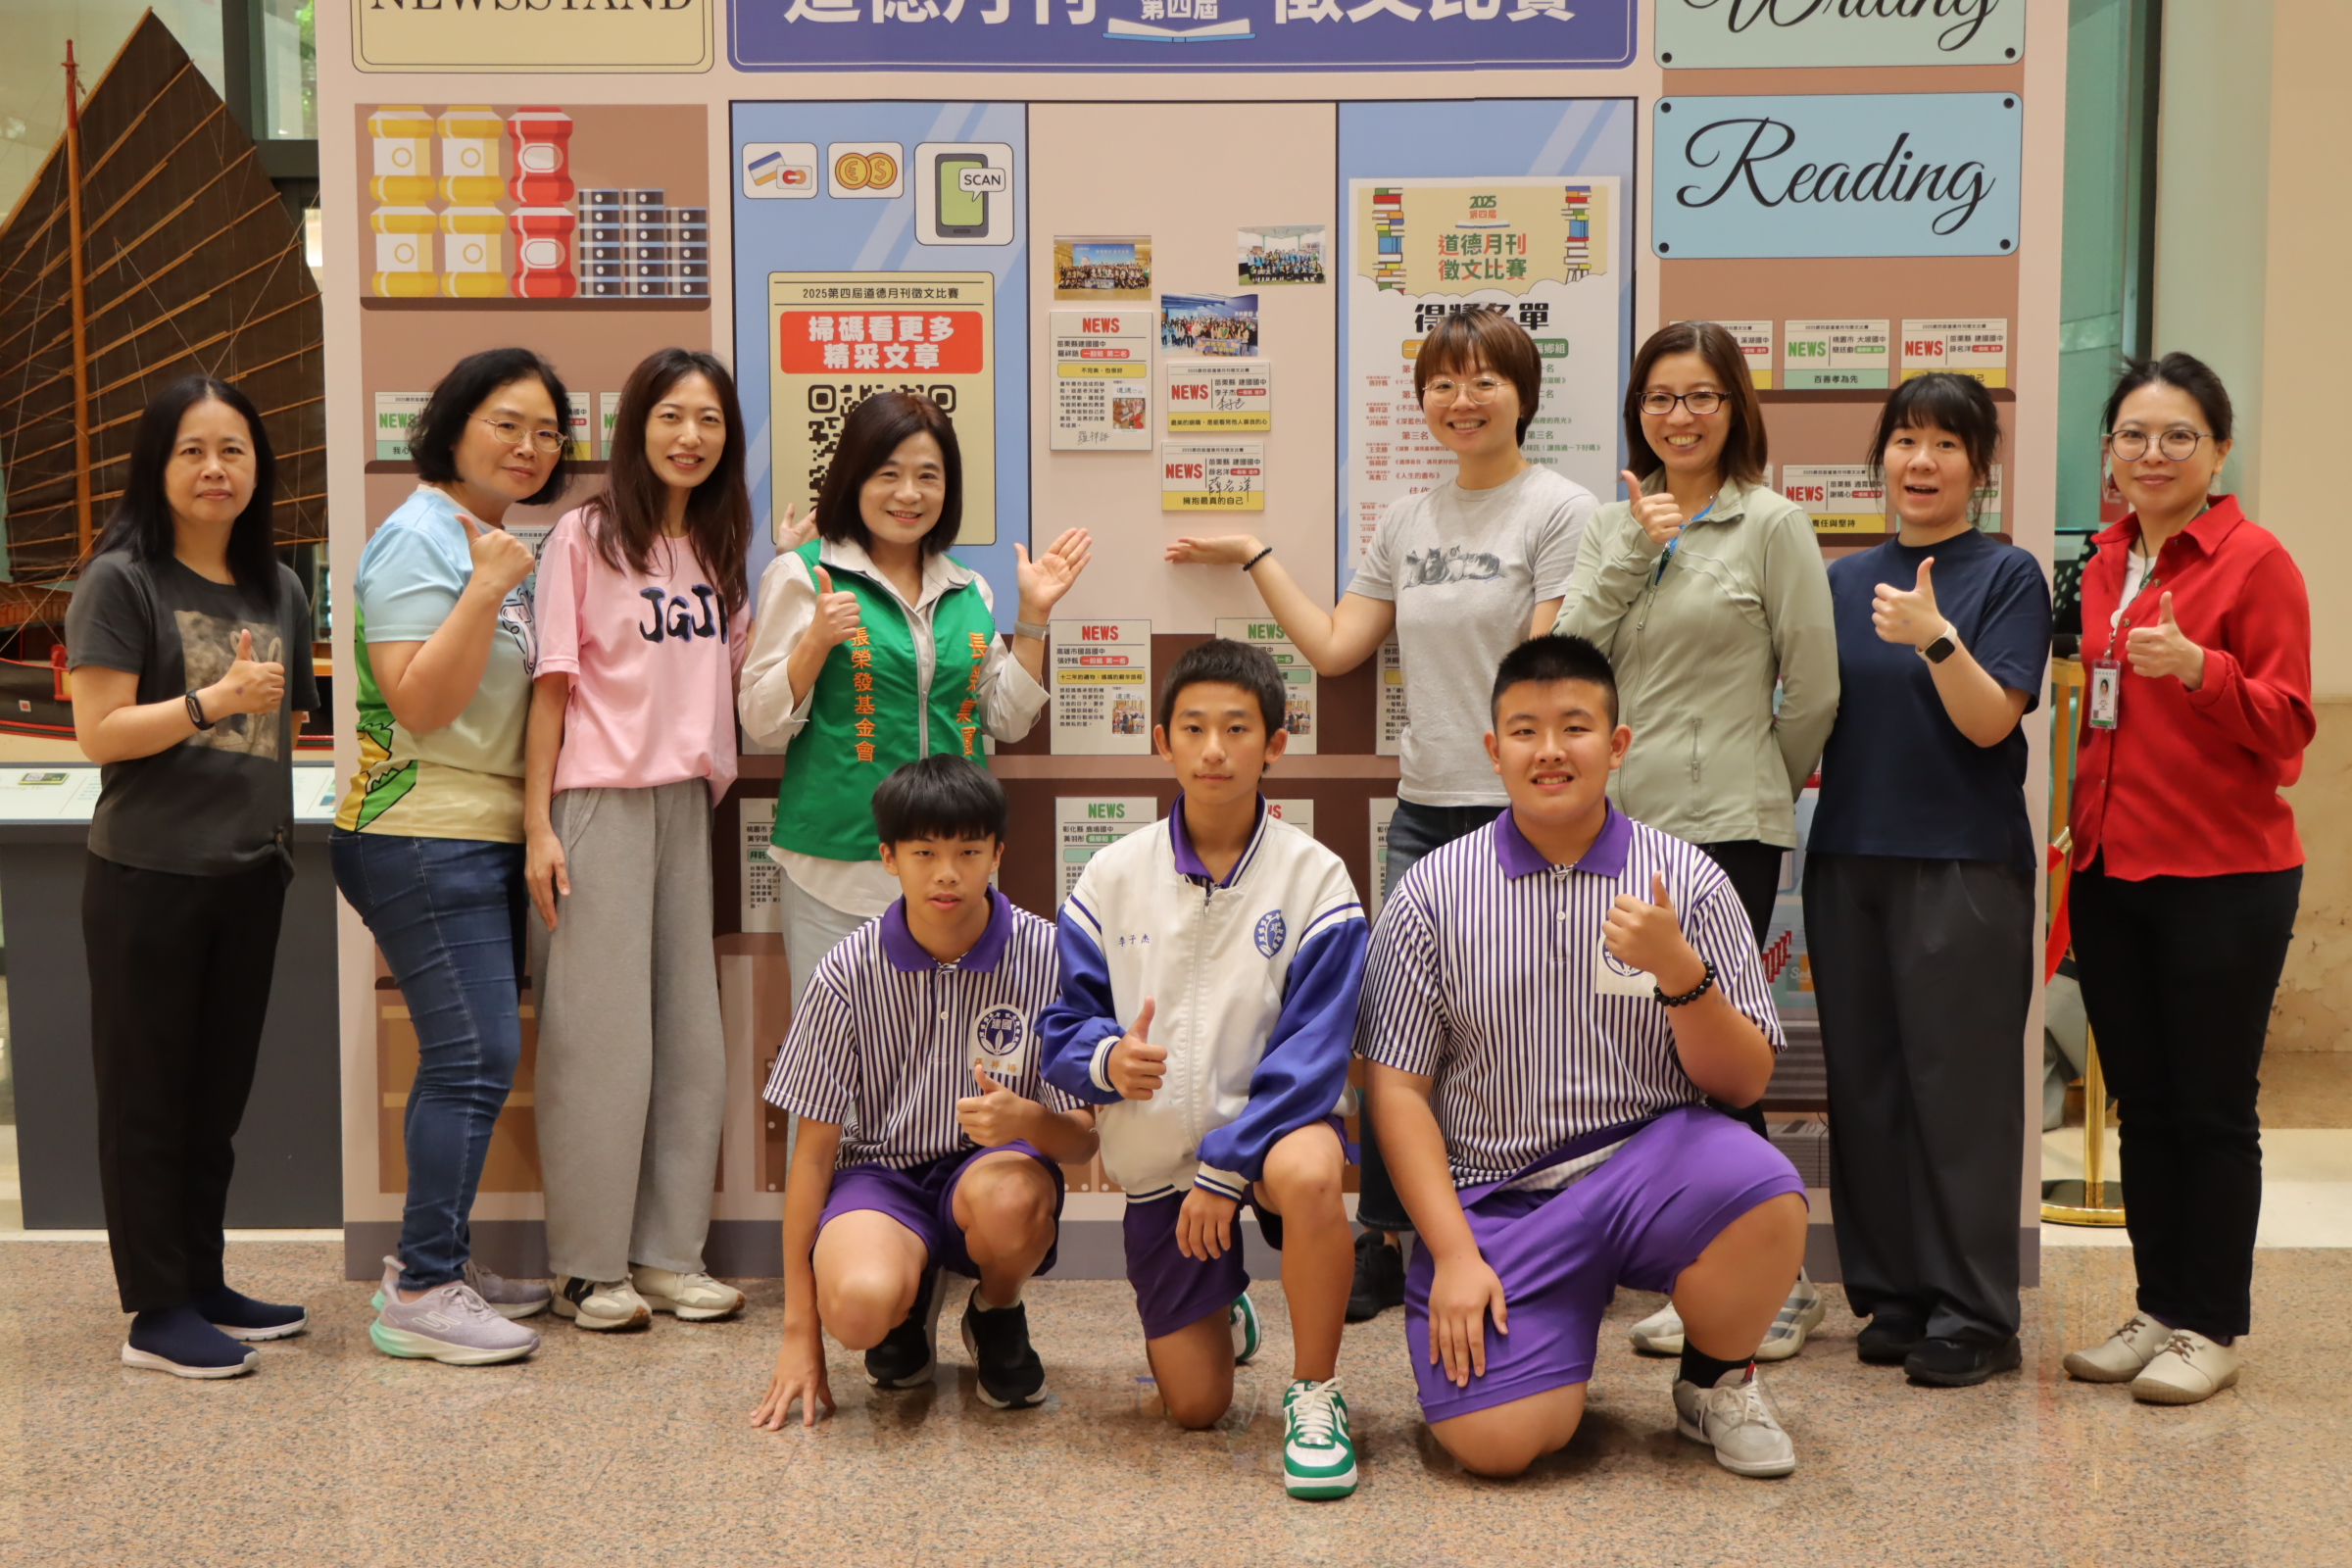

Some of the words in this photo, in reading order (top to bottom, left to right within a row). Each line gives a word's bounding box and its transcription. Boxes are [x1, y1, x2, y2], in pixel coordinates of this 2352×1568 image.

[962, 172, 1002, 188] SCAN
[1675, 116, 1996, 235] Reading
[1469, 195, 1497, 209] 2025
[1469, 210, 1497, 220] 第四屆
[1438, 232, 1527, 257] 道德月刊
[1438, 258, 1528, 281] 徵文比賽
[803, 287, 959, 300] 2025第四屆道德月刊徵文比賽
[808, 316, 955, 342] 掃碼看更多
[1082, 318, 1120, 333] NEWS
[823, 343, 940, 369] 精采文章
[1788, 341, 1826, 357] NEWS
[1904, 340, 1943, 357] NEWS
[1814, 375, 1859, 384] 百善孝為先
[1171, 384, 1209, 400] NEWS
[1401, 431, 1429, 440] 第三名
[1527, 430, 1554, 440] 第三名
[1165, 463, 1202, 479] NEWS
[1183, 497, 1244, 506] 擁抱最真的自己
[1786, 485, 1824, 502] NEWS
[1082, 625, 1119, 641] NEWS
[1248, 623, 1286, 639] NEWS
[1088, 803, 1125, 818] NEWS
